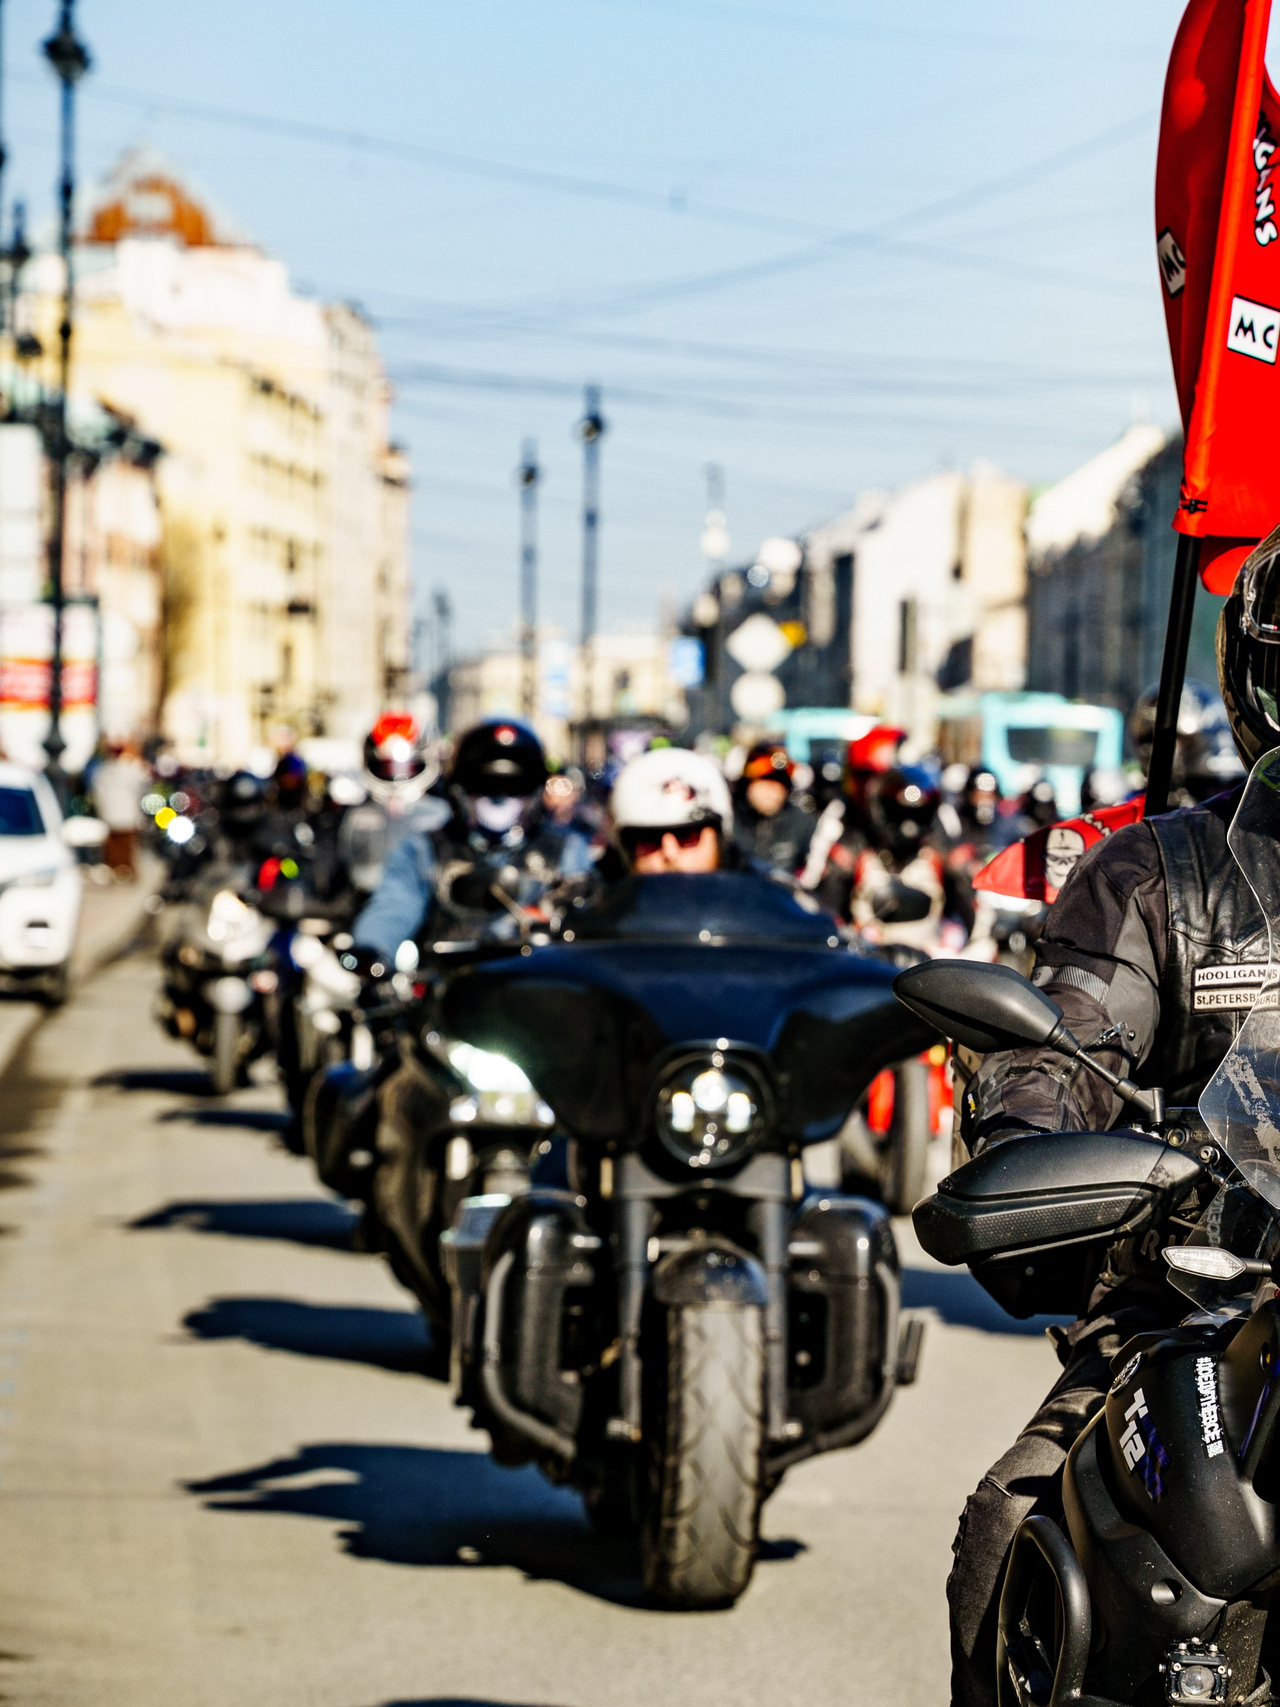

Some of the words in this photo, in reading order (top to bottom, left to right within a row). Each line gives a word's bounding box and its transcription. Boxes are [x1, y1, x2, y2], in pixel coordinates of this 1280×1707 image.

[1161, 243, 1187, 283] MC
[1234, 315, 1275, 350] MC
[1197, 968, 1278, 982] HOOLIGANS
